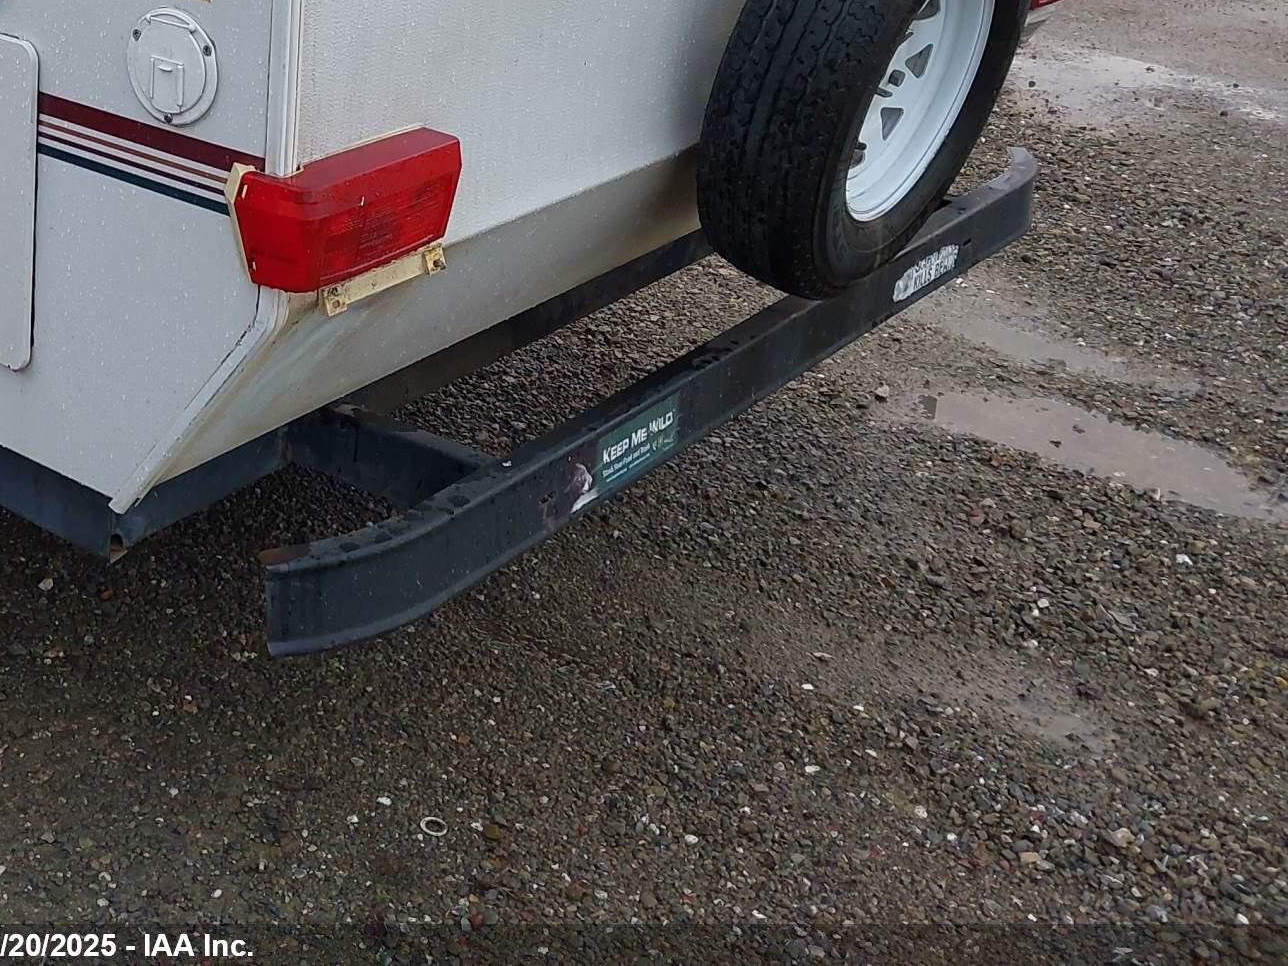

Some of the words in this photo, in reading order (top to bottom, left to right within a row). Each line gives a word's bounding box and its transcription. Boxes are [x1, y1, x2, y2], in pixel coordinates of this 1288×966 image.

[602, 438, 630, 465] KEEP
[631, 427, 648, 449] ME
[649, 411, 674, 434] WILD
